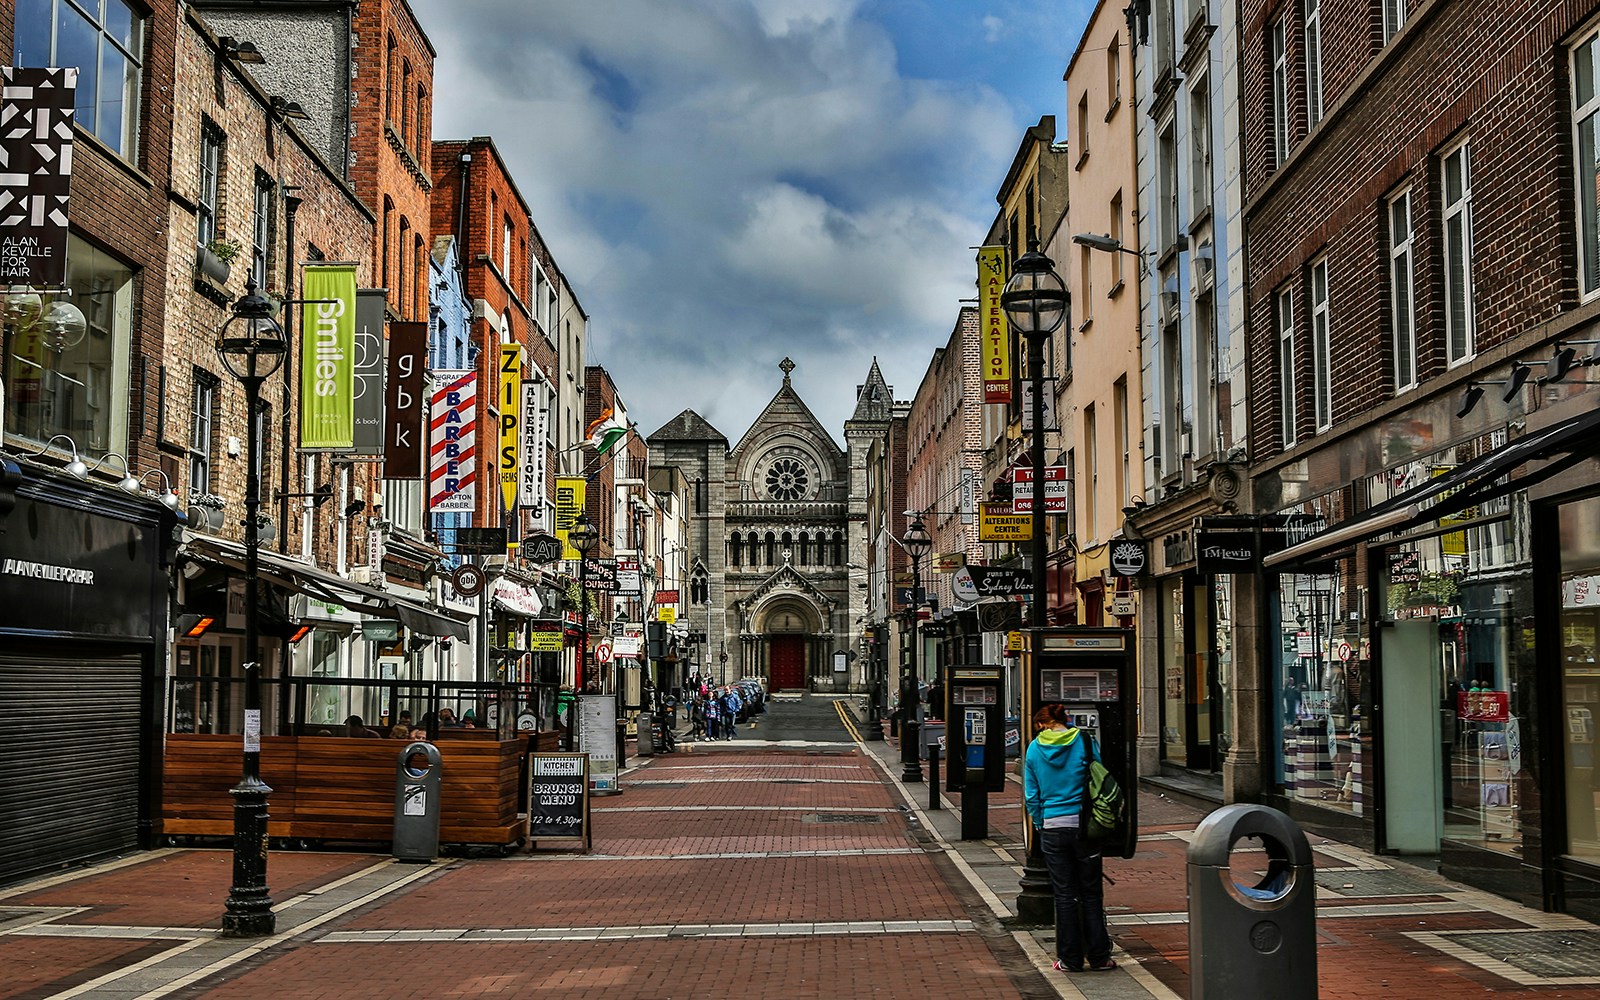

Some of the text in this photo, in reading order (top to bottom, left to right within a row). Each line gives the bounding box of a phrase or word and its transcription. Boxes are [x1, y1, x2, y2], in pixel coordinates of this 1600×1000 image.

[3, 236, 39, 246] ALAN
[2, 246, 52, 257] KEVILLE
[2, 256, 27, 267] FOR
[1, 267, 31, 277] HAIR
[988, 277, 1002, 376] ALTERATION
[315, 296, 346, 398] Smiles
[986, 384, 1009, 392] CENTRE
[395, 354, 414, 448] gbk
[501, 350, 518, 471] ZIPS
[363, 417, 380, 426] body
[444, 391, 462, 494] BARBER
[524, 385, 536, 494] ALTERATIONS
[501, 472, 518, 483] HEMS
[1015, 484, 1066, 496] RETAI FFICES
[556, 487, 576, 531] GOTHAM
[984, 517, 1030, 525] ALTERATIONS
[994, 525, 1020, 533] CENTRE
[525, 541, 558, 559] EAT
[461, 575, 476, 585] gbk
[585, 580, 614, 589] OUNGE
[979, 578, 1012, 595] Sydney
[543, 762, 575, 770] KITCHEN
[533, 784, 583, 795] BRUNCH
[540, 794, 576, 805] MENU
[532, 815, 542, 824] 12
[544, 816, 554, 824] to
